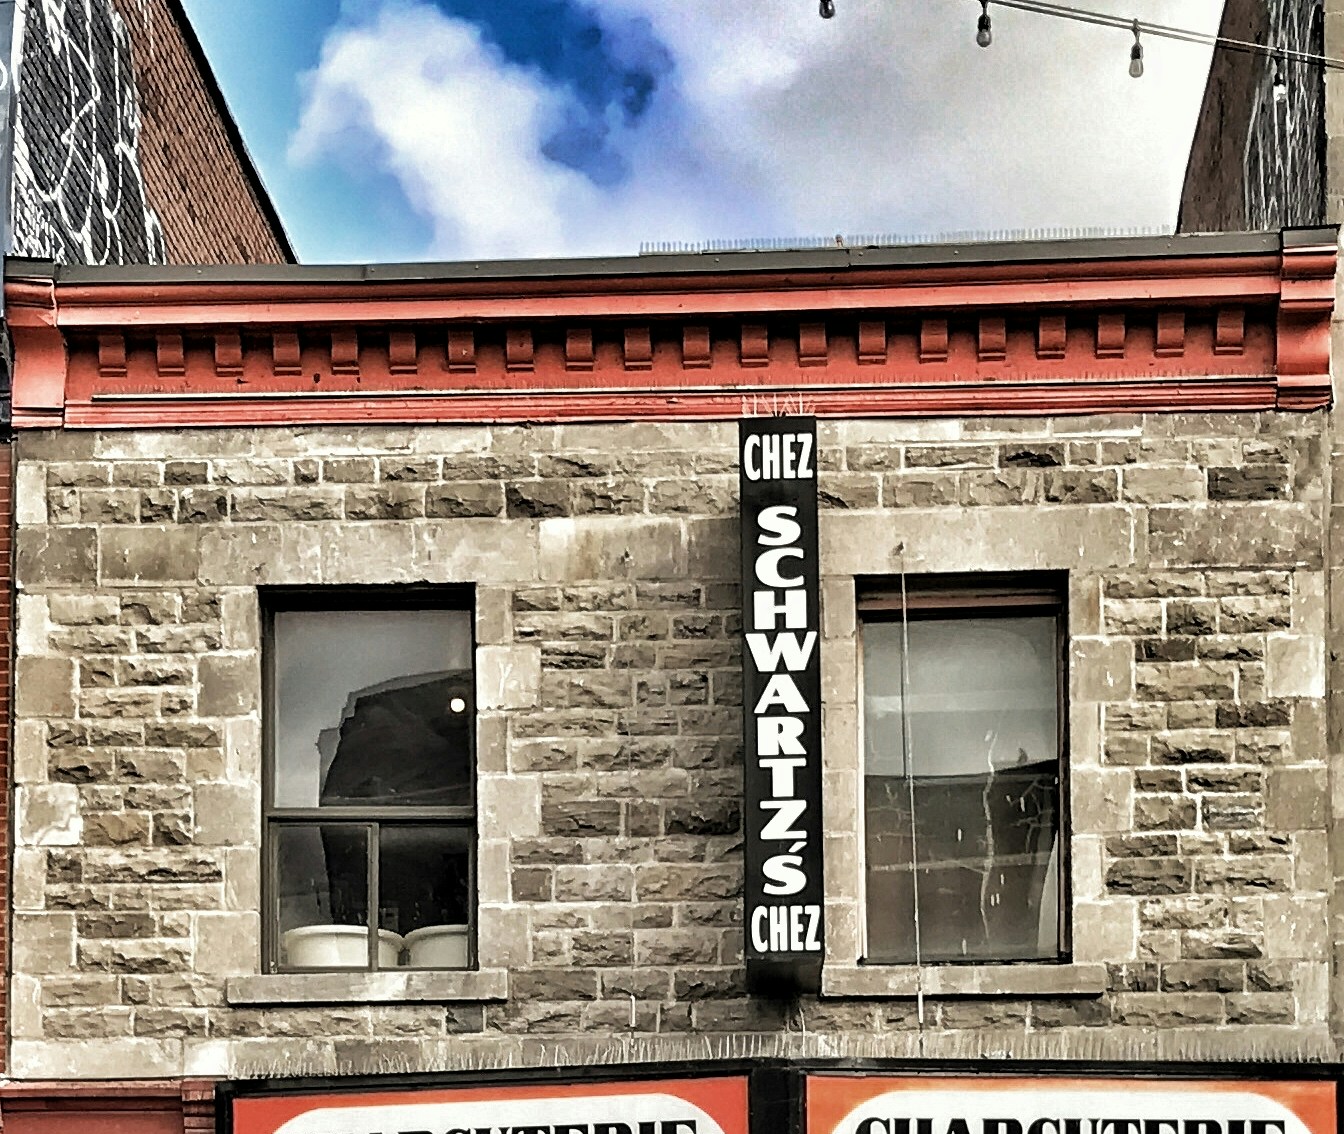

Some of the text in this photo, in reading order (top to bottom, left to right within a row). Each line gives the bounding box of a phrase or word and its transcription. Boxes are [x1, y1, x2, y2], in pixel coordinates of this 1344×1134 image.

[744, 433, 814, 481] CHEZ
[745, 505, 818, 896] SCHWARTZ'S
[751, 905, 821, 953] CHEZ
